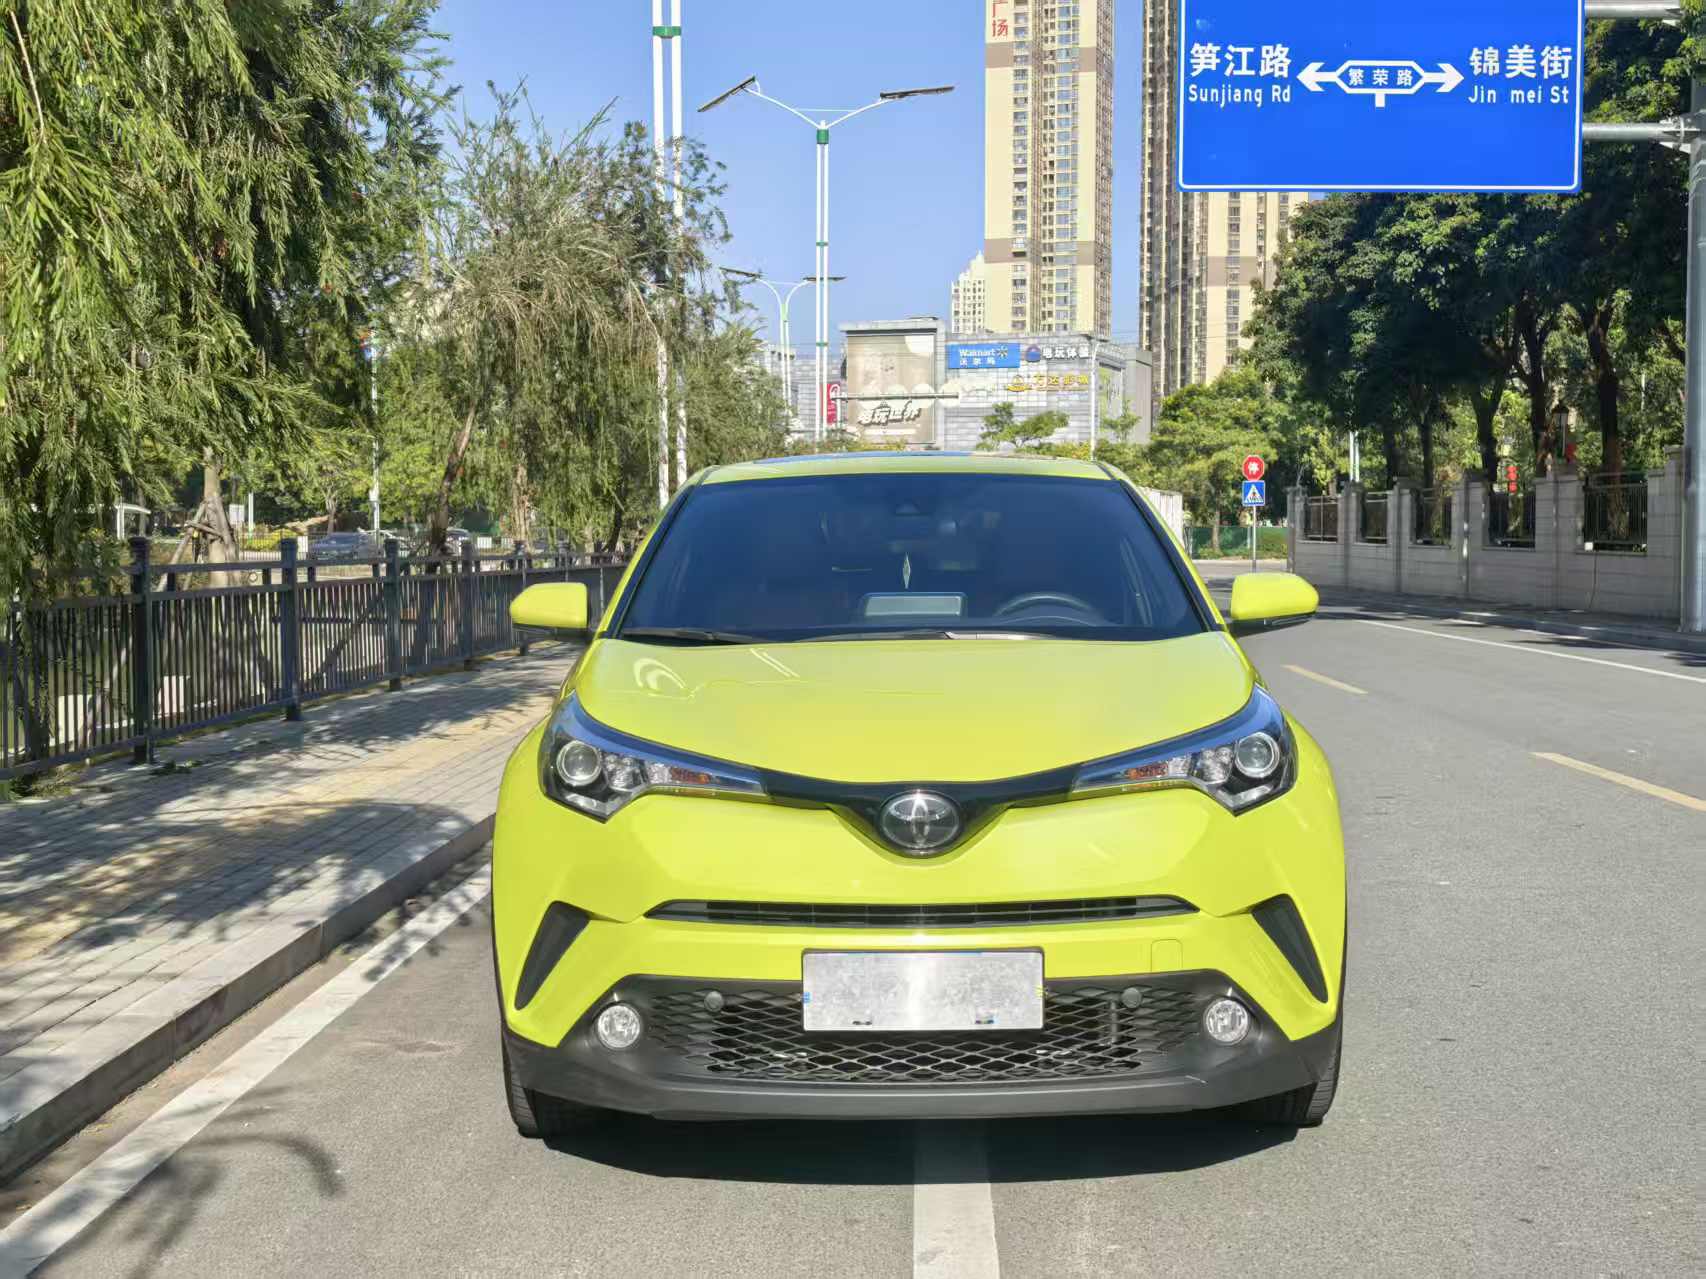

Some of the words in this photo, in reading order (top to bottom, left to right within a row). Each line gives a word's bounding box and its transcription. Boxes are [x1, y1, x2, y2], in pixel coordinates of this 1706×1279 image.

[1190, 43, 1292, 78] 笋江路
[1469, 45, 1573, 79] 锦美街
[1348, 68, 1414, 86] 繁荣路
[1188, 84, 1263, 108] Sunjiang
[1271, 84, 1291, 103] Rd
[1469, 85, 1497, 104] Jin
[1510, 86, 1542, 104] mei
[1550, 85, 1569, 104] St
